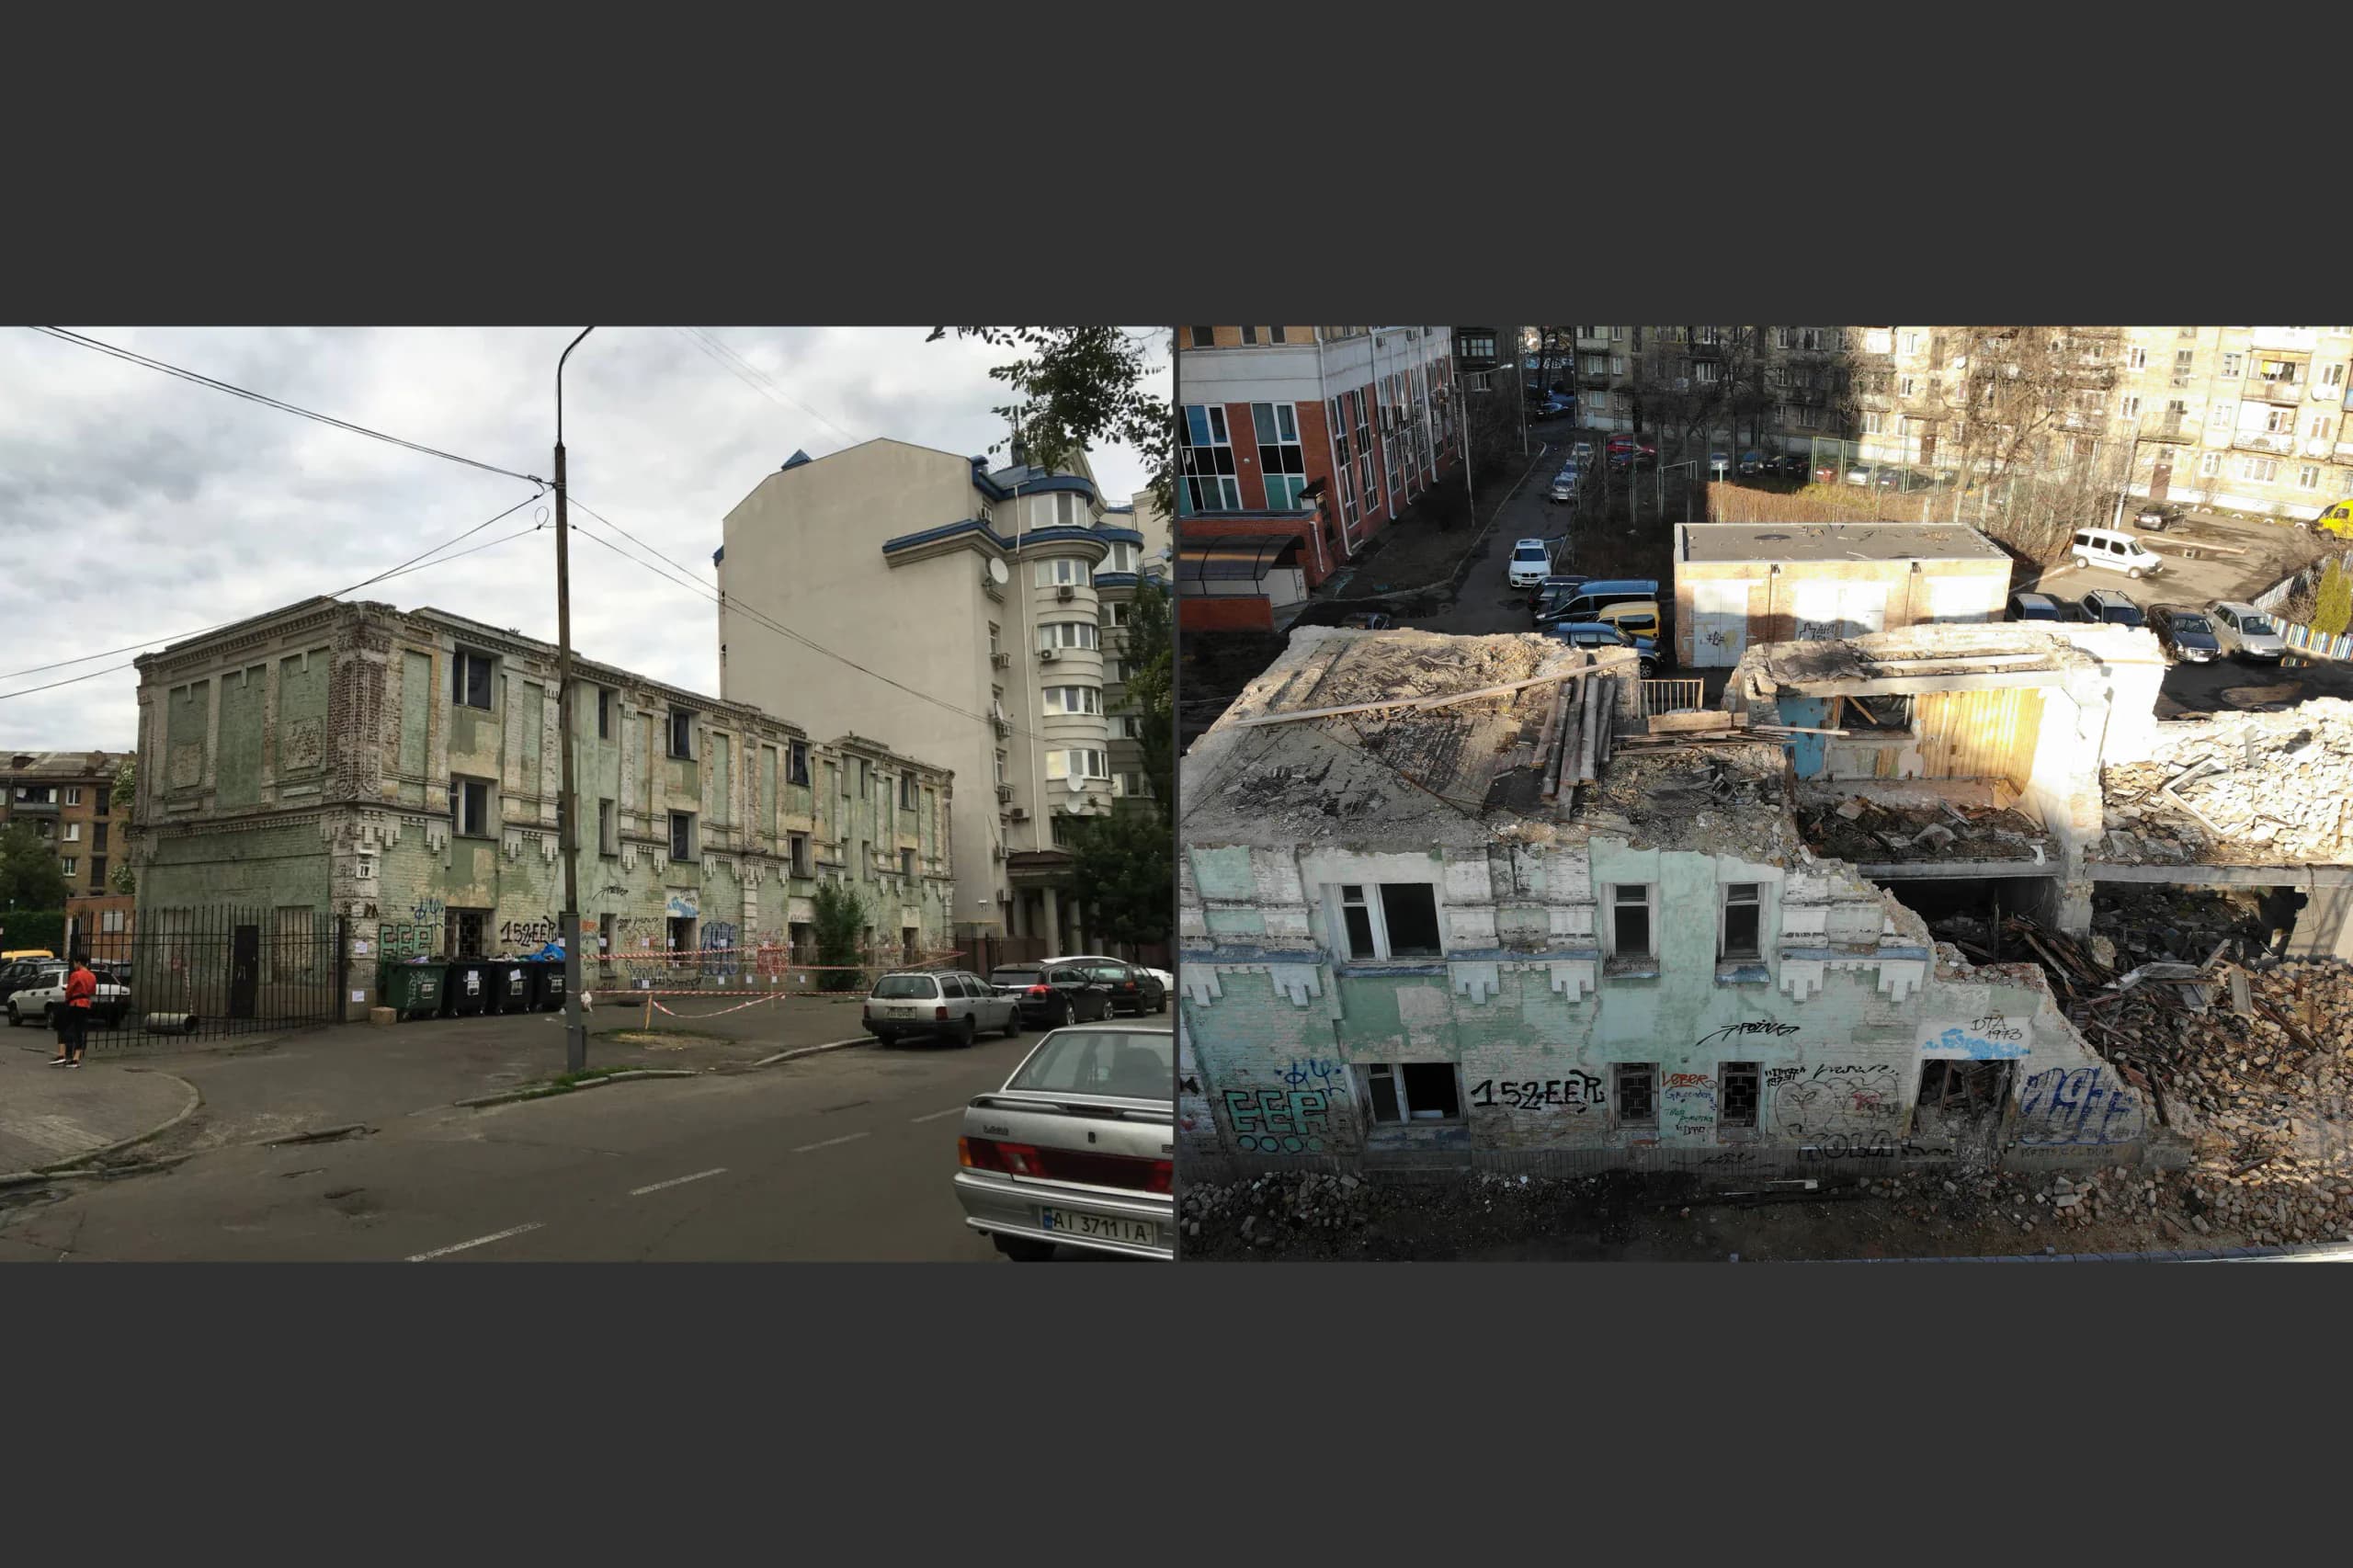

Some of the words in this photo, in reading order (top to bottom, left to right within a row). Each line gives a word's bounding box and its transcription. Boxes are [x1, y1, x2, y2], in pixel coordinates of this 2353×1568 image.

[1053, 1211, 1074, 1230] AI
[1080, 1216, 1119, 1237] 3711
[1125, 1222, 1148, 1242] IA
